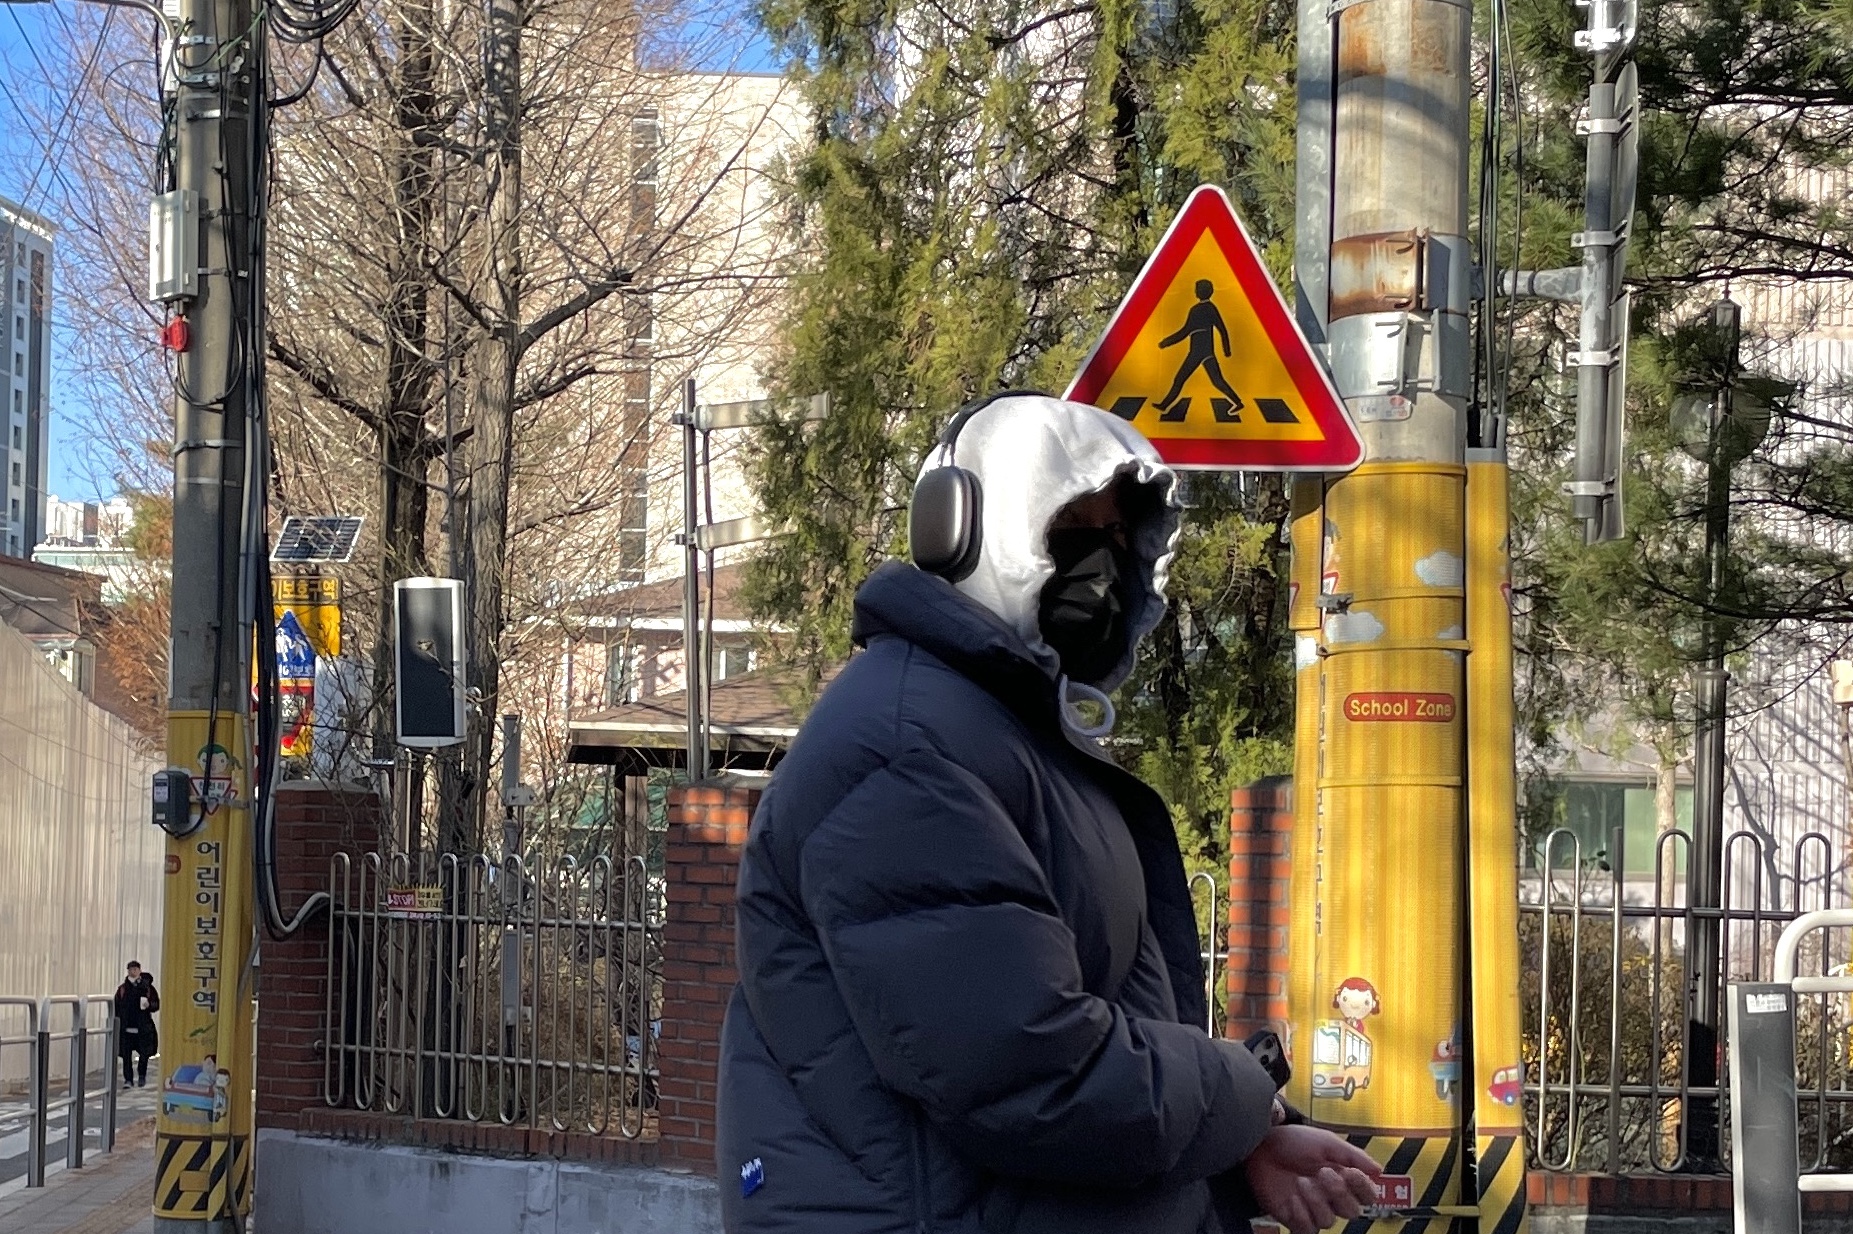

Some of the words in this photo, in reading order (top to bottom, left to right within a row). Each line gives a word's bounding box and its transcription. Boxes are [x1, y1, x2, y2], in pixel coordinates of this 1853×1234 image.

[1350, 698, 1409, 716] School
[1415, 699, 1454, 717] Zone
[192, 840, 221, 1014] 어린이보호구역
